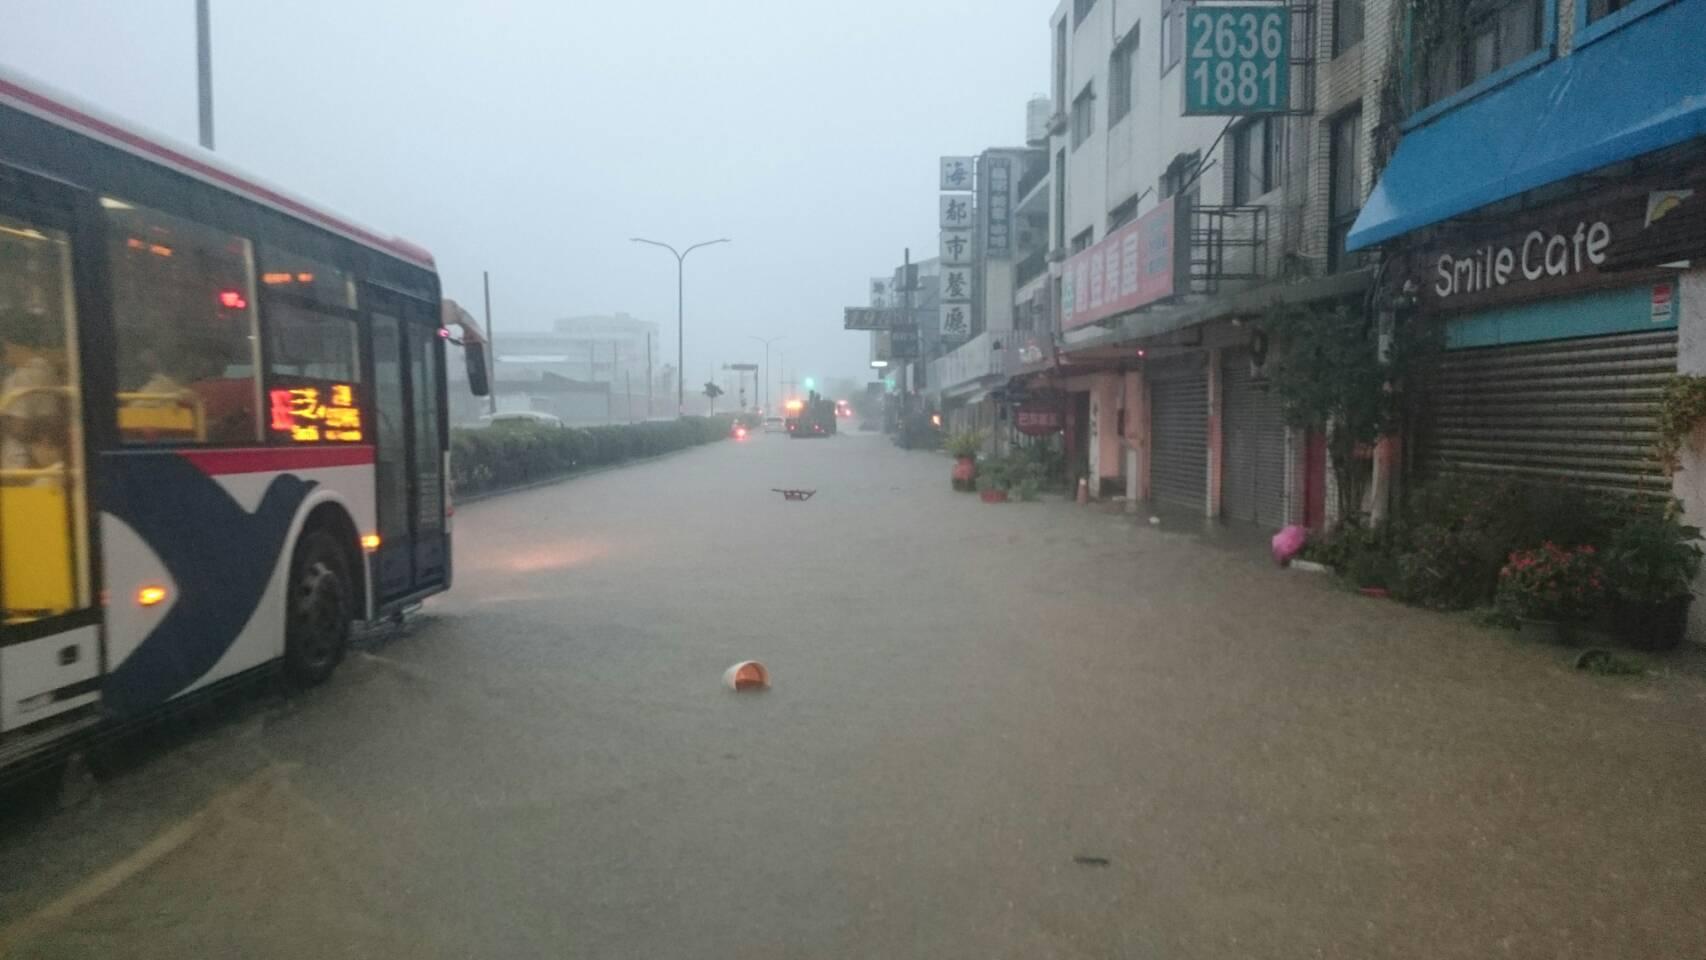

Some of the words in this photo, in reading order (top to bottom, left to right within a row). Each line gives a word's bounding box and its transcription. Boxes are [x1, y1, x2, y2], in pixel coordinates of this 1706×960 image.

[1192, 13, 1282, 59] 2636
[1193, 60, 1277, 106] 1881
[944, 161, 968, 334] 海都市餐廳
[1435, 246, 1515, 297] Smile
[1521, 221, 1611, 281] Cafe
